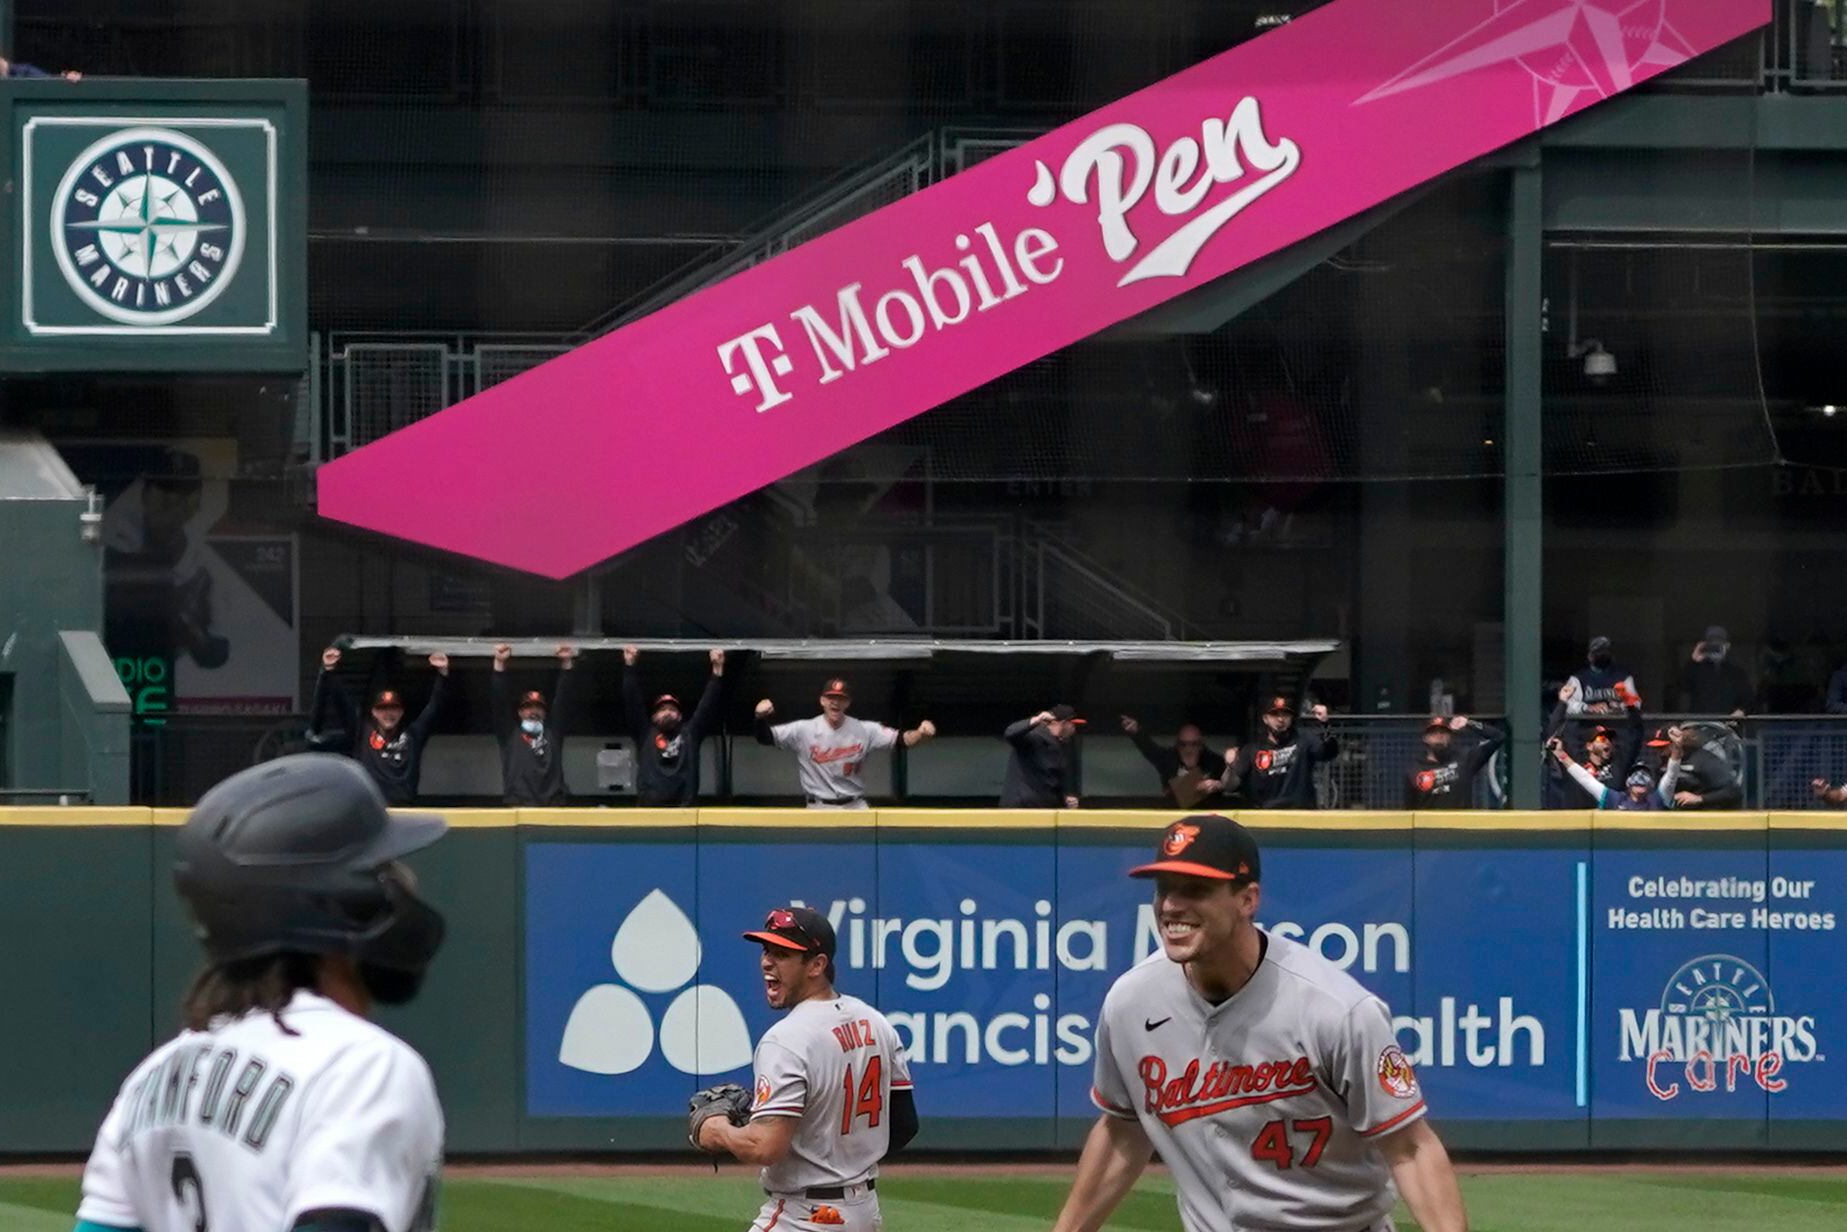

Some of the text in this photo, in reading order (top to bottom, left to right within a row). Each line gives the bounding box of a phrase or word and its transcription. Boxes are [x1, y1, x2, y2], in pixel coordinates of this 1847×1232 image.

[74, 146, 221, 207] SEATTLE
[74, 242, 224, 307] MARINERS
[790, 222, 1064, 384] Mobile
[1627, 876, 1815, 903] Celebrating Our
[1608, 908, 1836, 930] Health Care Heroes
[832, 1019, 876, 1053] RUIZ
[1617, 1008, 1817, 1062] MARINERS
[840, 1055, 882, 1135] 14
[1138, 1055, 1319, 1116] Baltimore
[1250, 1115, 1333, 1171] 47
